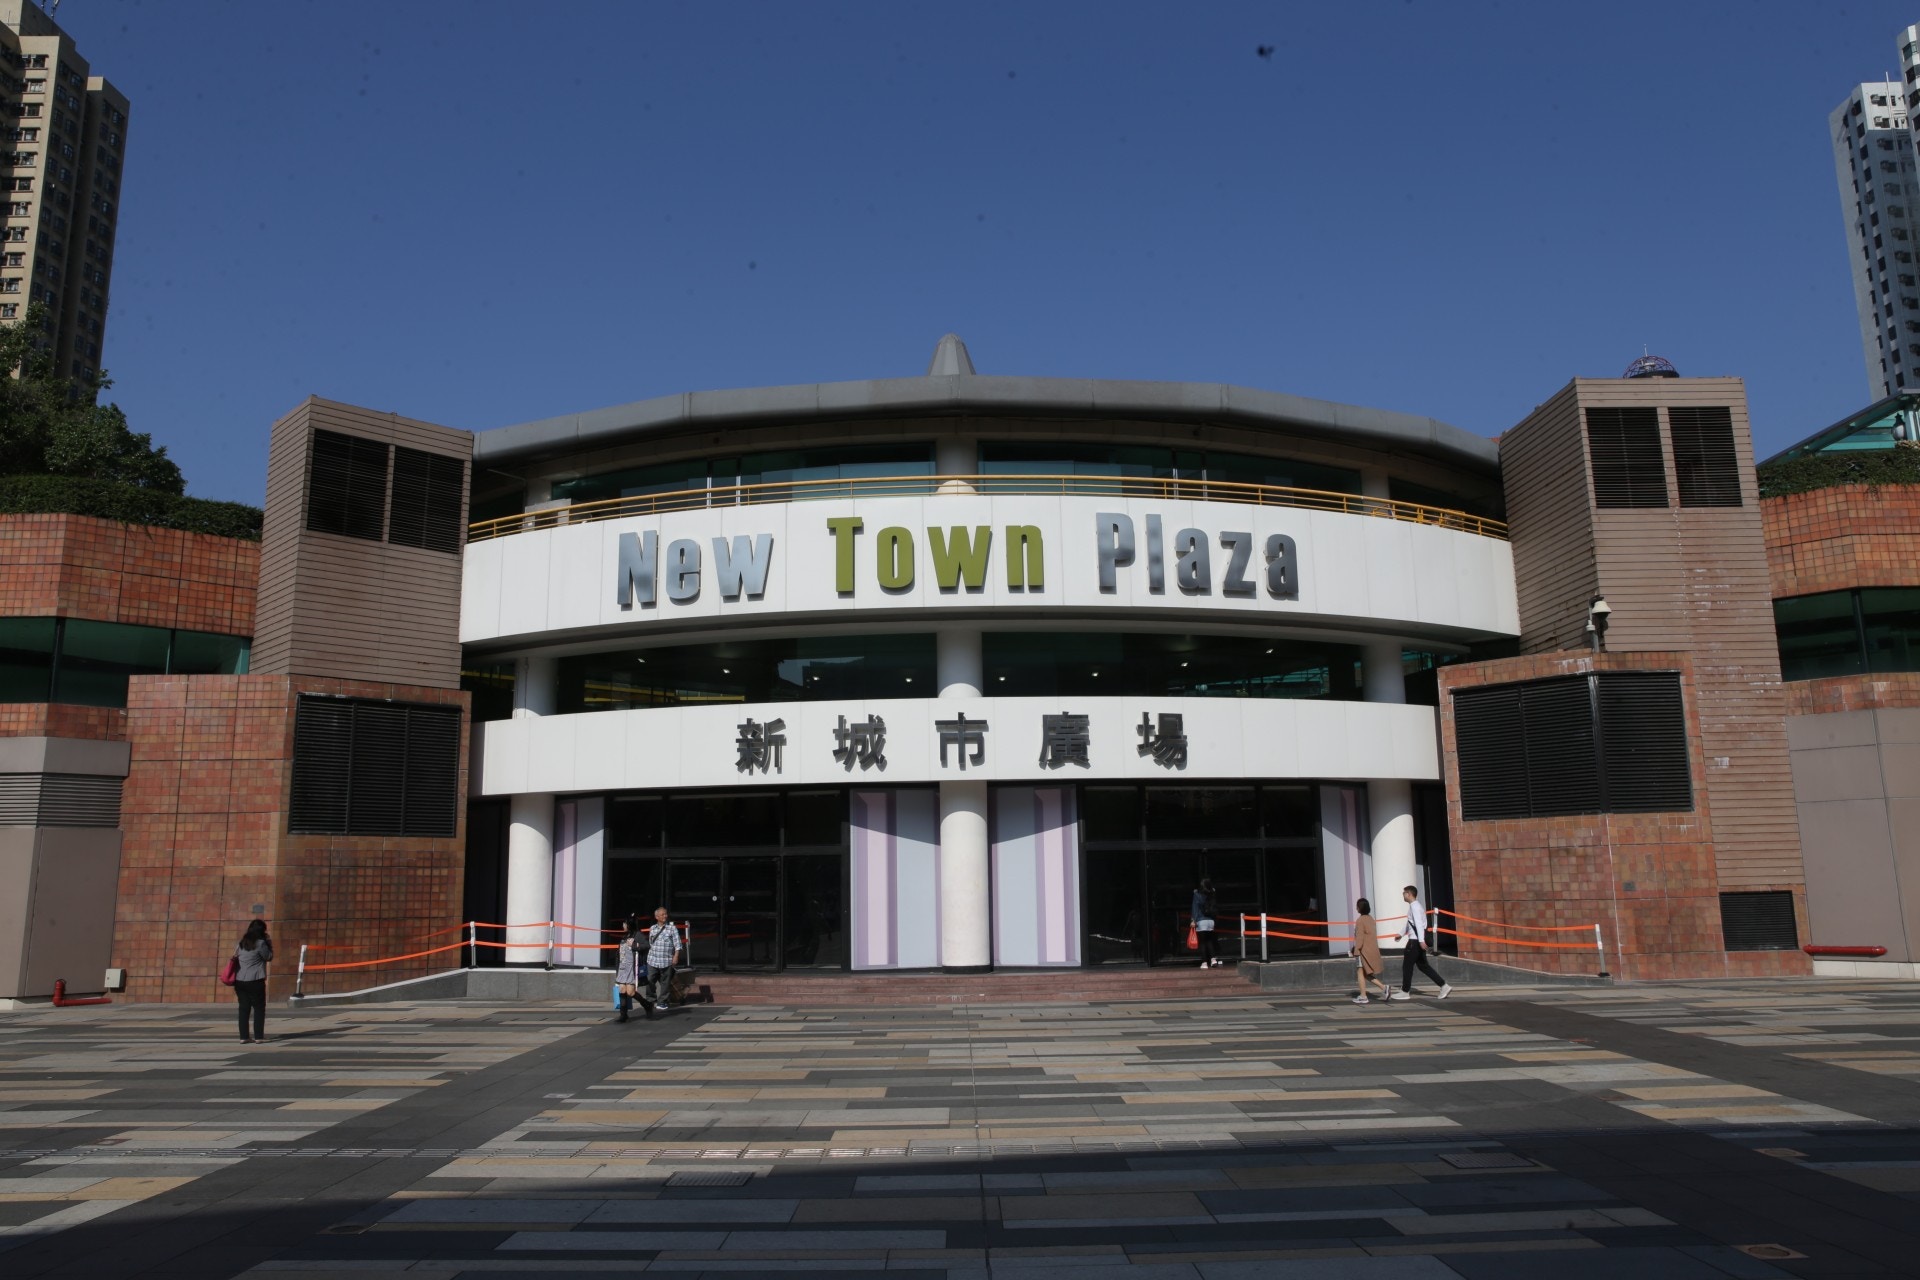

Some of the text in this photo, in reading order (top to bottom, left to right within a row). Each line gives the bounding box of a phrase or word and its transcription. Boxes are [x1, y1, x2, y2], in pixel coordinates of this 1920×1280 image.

[619, 512, 1298, 607] New Town Plaza
[735, 711, 1188, 774] 新城市廣場
